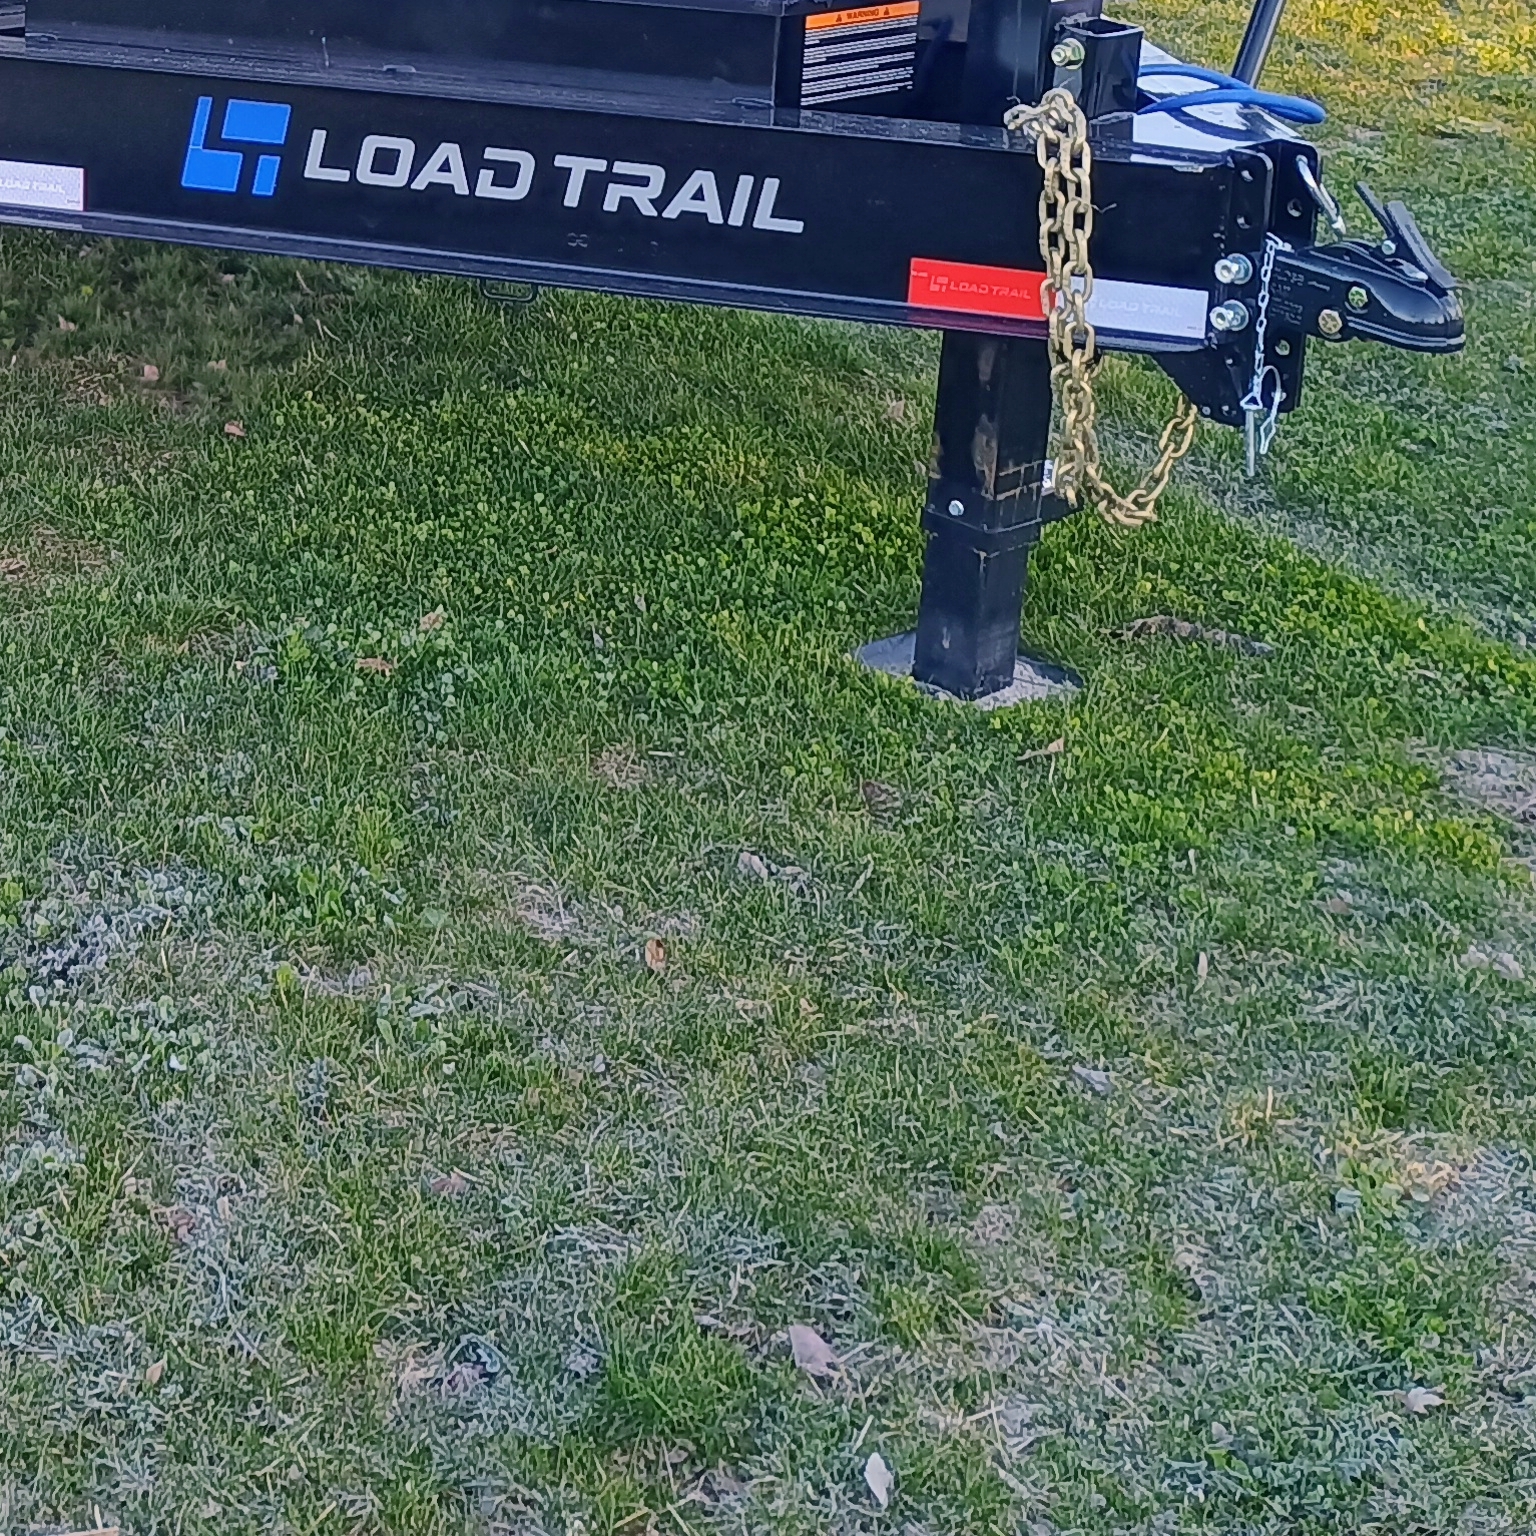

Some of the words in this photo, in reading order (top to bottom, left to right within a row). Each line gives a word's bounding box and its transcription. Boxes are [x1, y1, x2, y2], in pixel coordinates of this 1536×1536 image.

[846, 8, 880, 20] WARNING
[304, 129, 536, 201] LOAD
[553, 153, 805, 234] TRAIL
[949, 280, 989, 295] LOAD
[991, 284, 1032, 300] TRAIL
